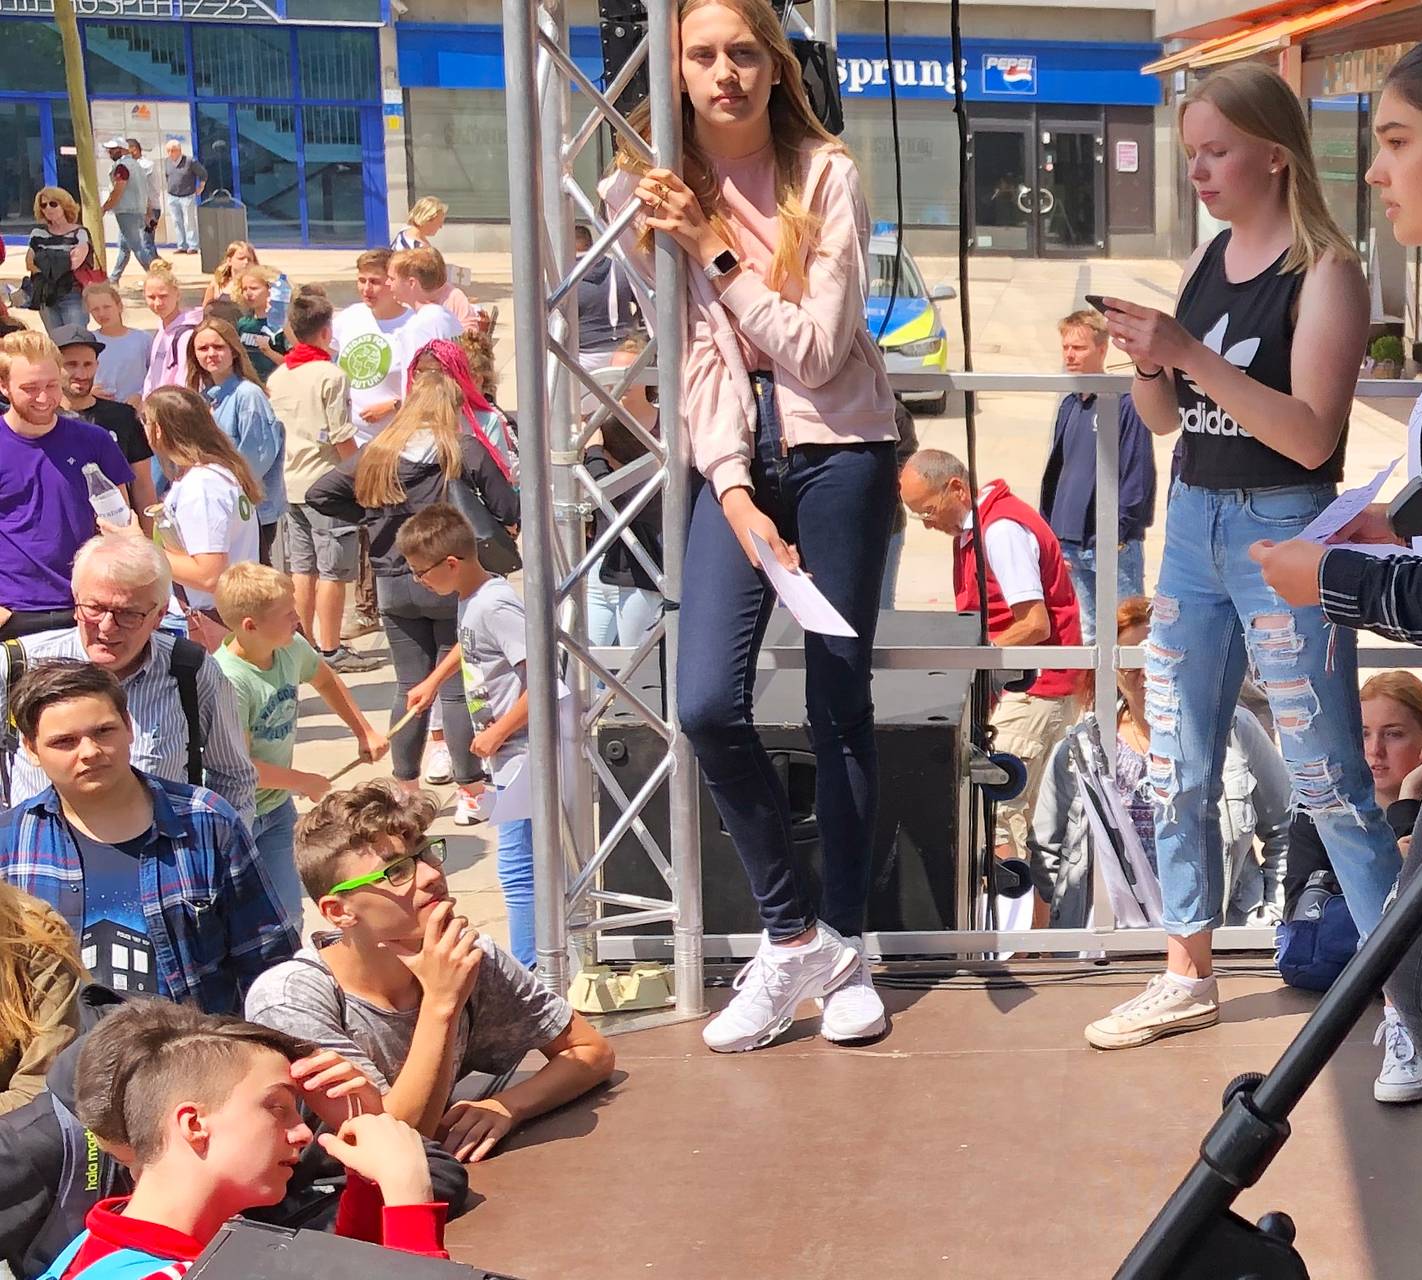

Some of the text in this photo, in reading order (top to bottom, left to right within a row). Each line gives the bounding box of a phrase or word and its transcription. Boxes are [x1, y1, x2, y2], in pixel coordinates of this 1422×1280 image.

[836, 57, 968, 95] sprung
[986, 57, 1033, 71] PEPSI
[341, 334, 389, 358] FRIDAYS FOR
[351, 371, 385, 389] FUTURE
[85, 1162, 98, 1191] hala
